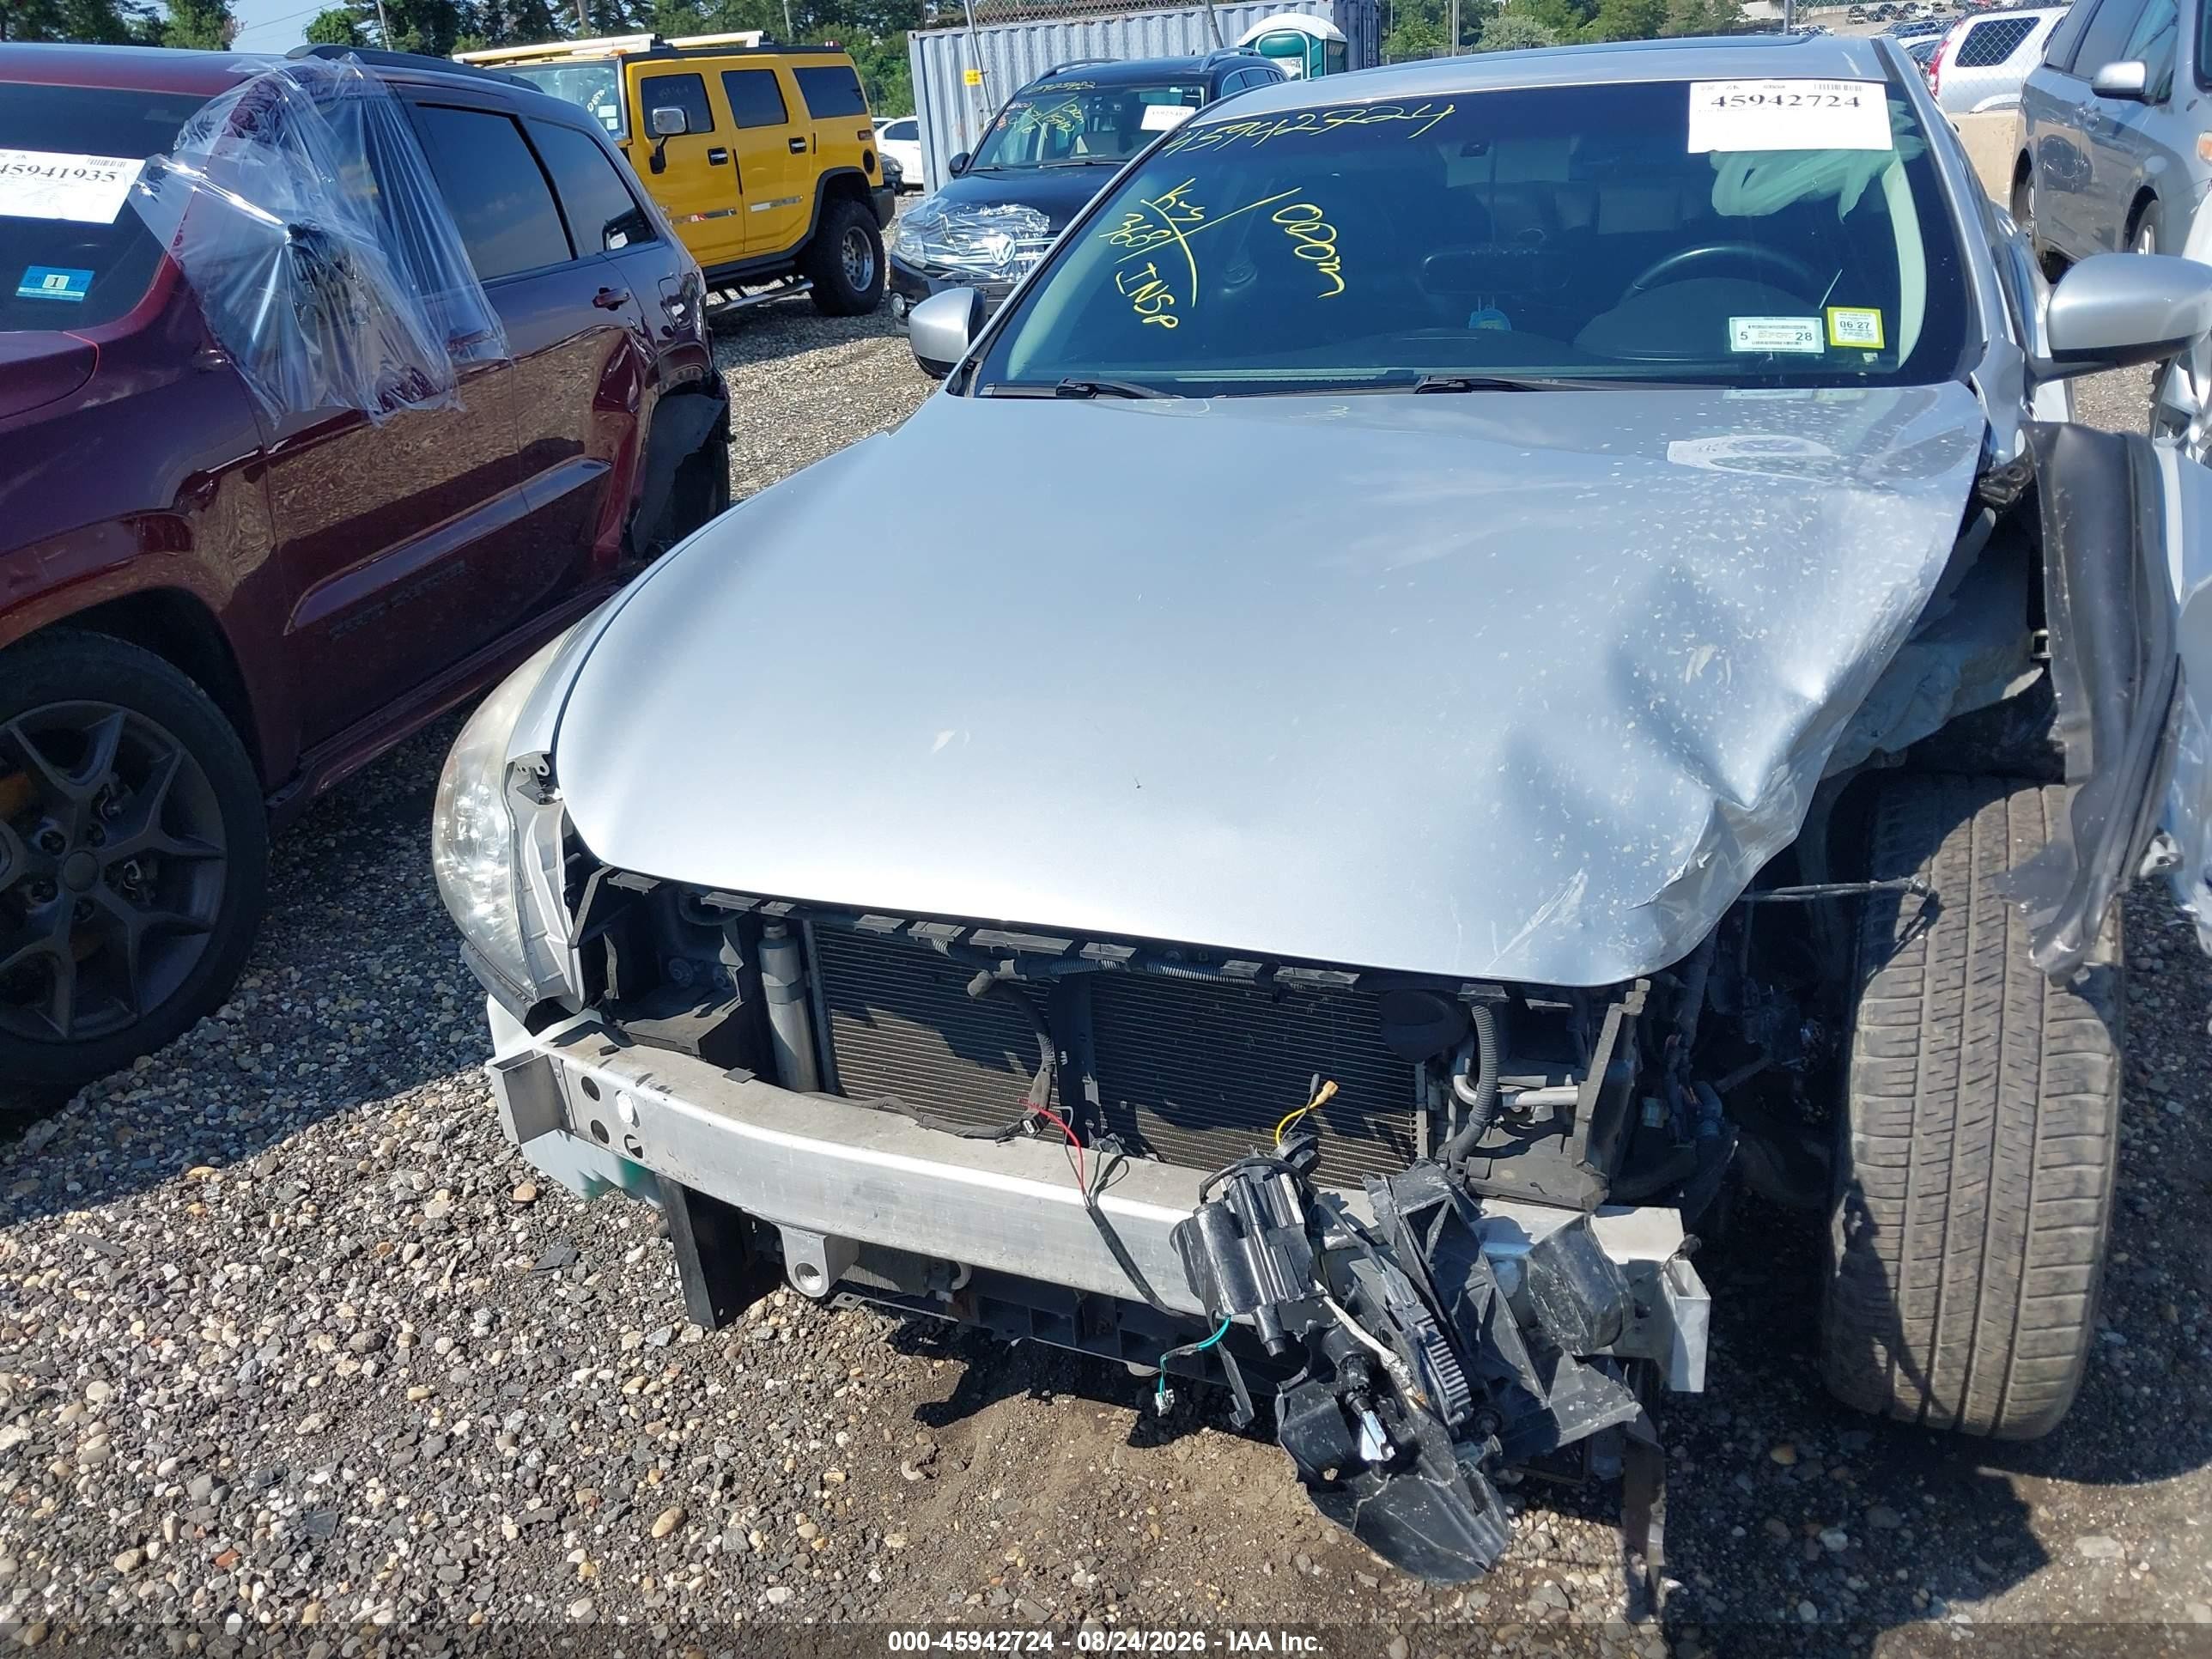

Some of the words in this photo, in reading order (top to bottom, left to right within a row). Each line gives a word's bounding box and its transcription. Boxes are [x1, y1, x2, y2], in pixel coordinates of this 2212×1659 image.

[1711, 94, 1860, 107] 45942724
[1162, 104, 1455, 158] 45942724
[51, 276, 59, 288] 1
[1839, 320, 1854, 329] 06
[1856, 321, 1870, 330] 27
[1740, 331, 1748, 341] 5
[1796, 332, 1813, 342] 28
